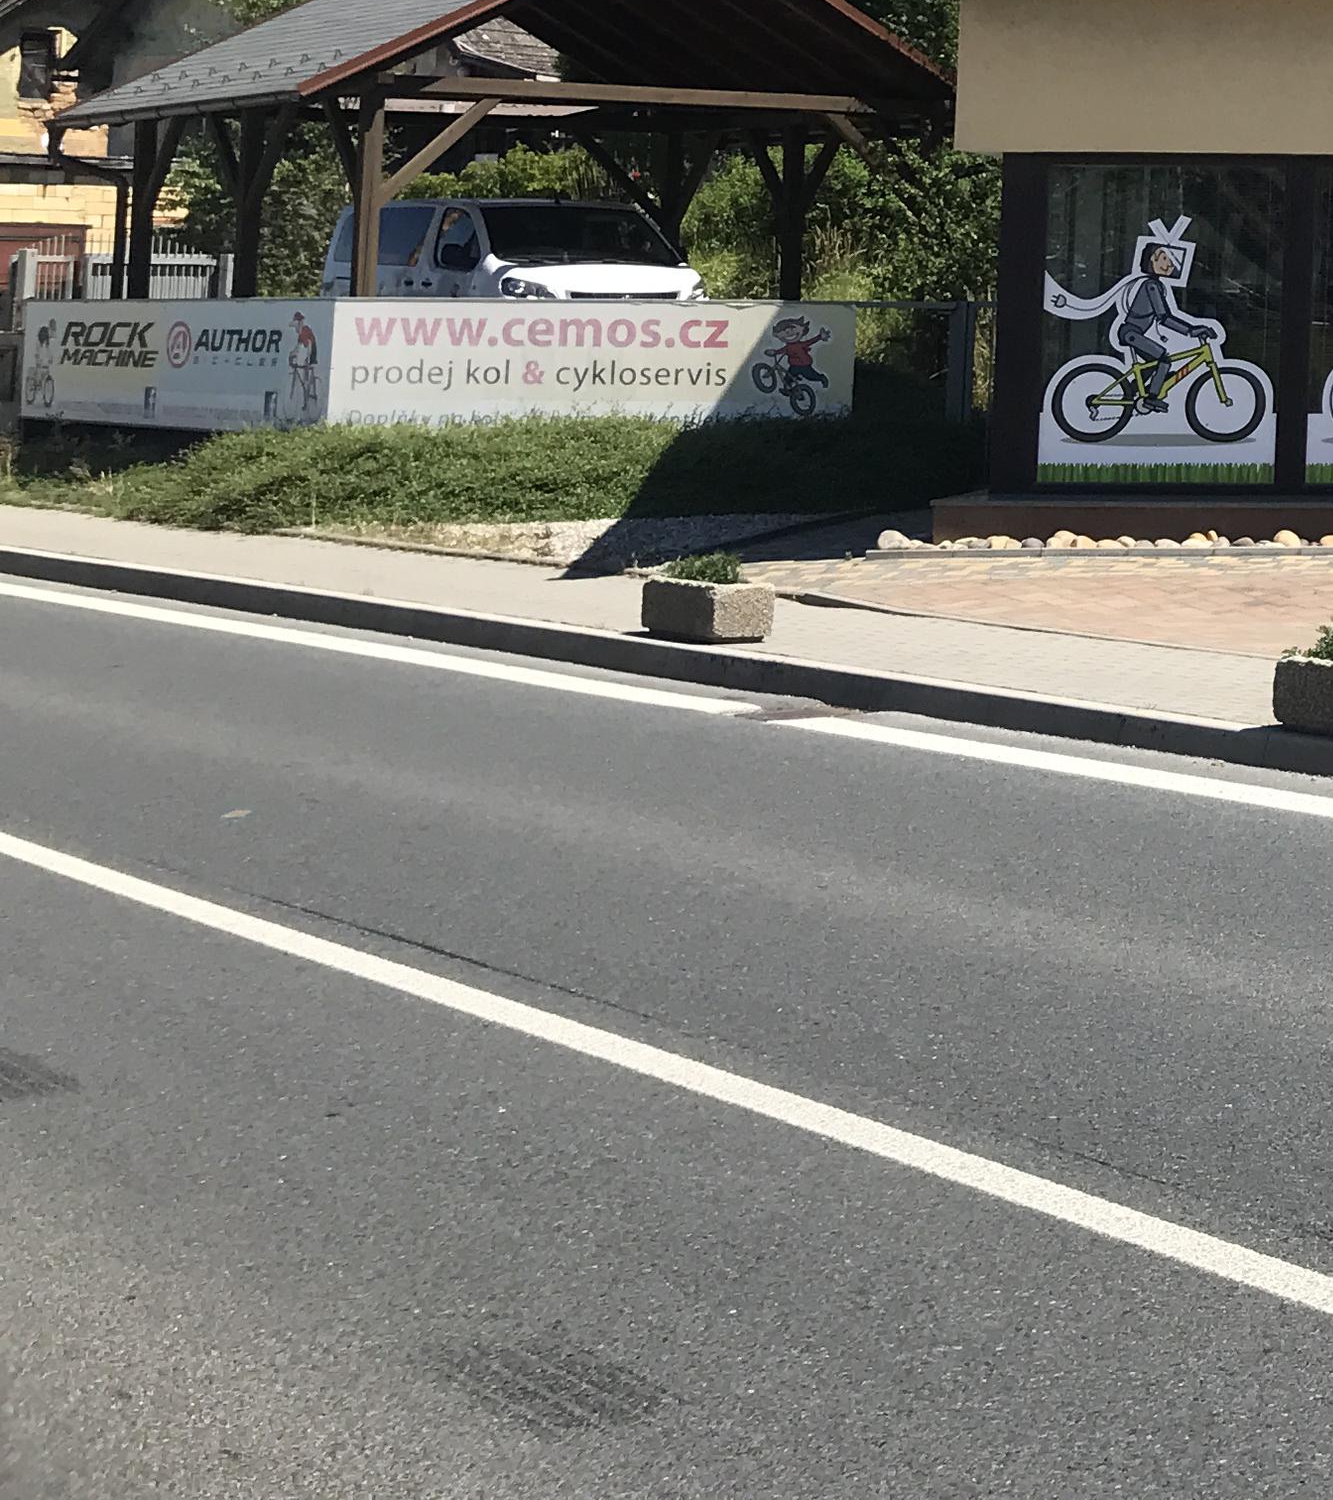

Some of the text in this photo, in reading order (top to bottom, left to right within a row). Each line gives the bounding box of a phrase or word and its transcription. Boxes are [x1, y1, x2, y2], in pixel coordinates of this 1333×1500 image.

[60, 321, 155, 349] ROCK
[193, 328, 283, 353] AUTHOR
[354, 316, 730, 349] www.cemos.cz
[60, 348, 158, 369] MACHINE
[351, 359, 728, 392] prodej kol & cykloservis
